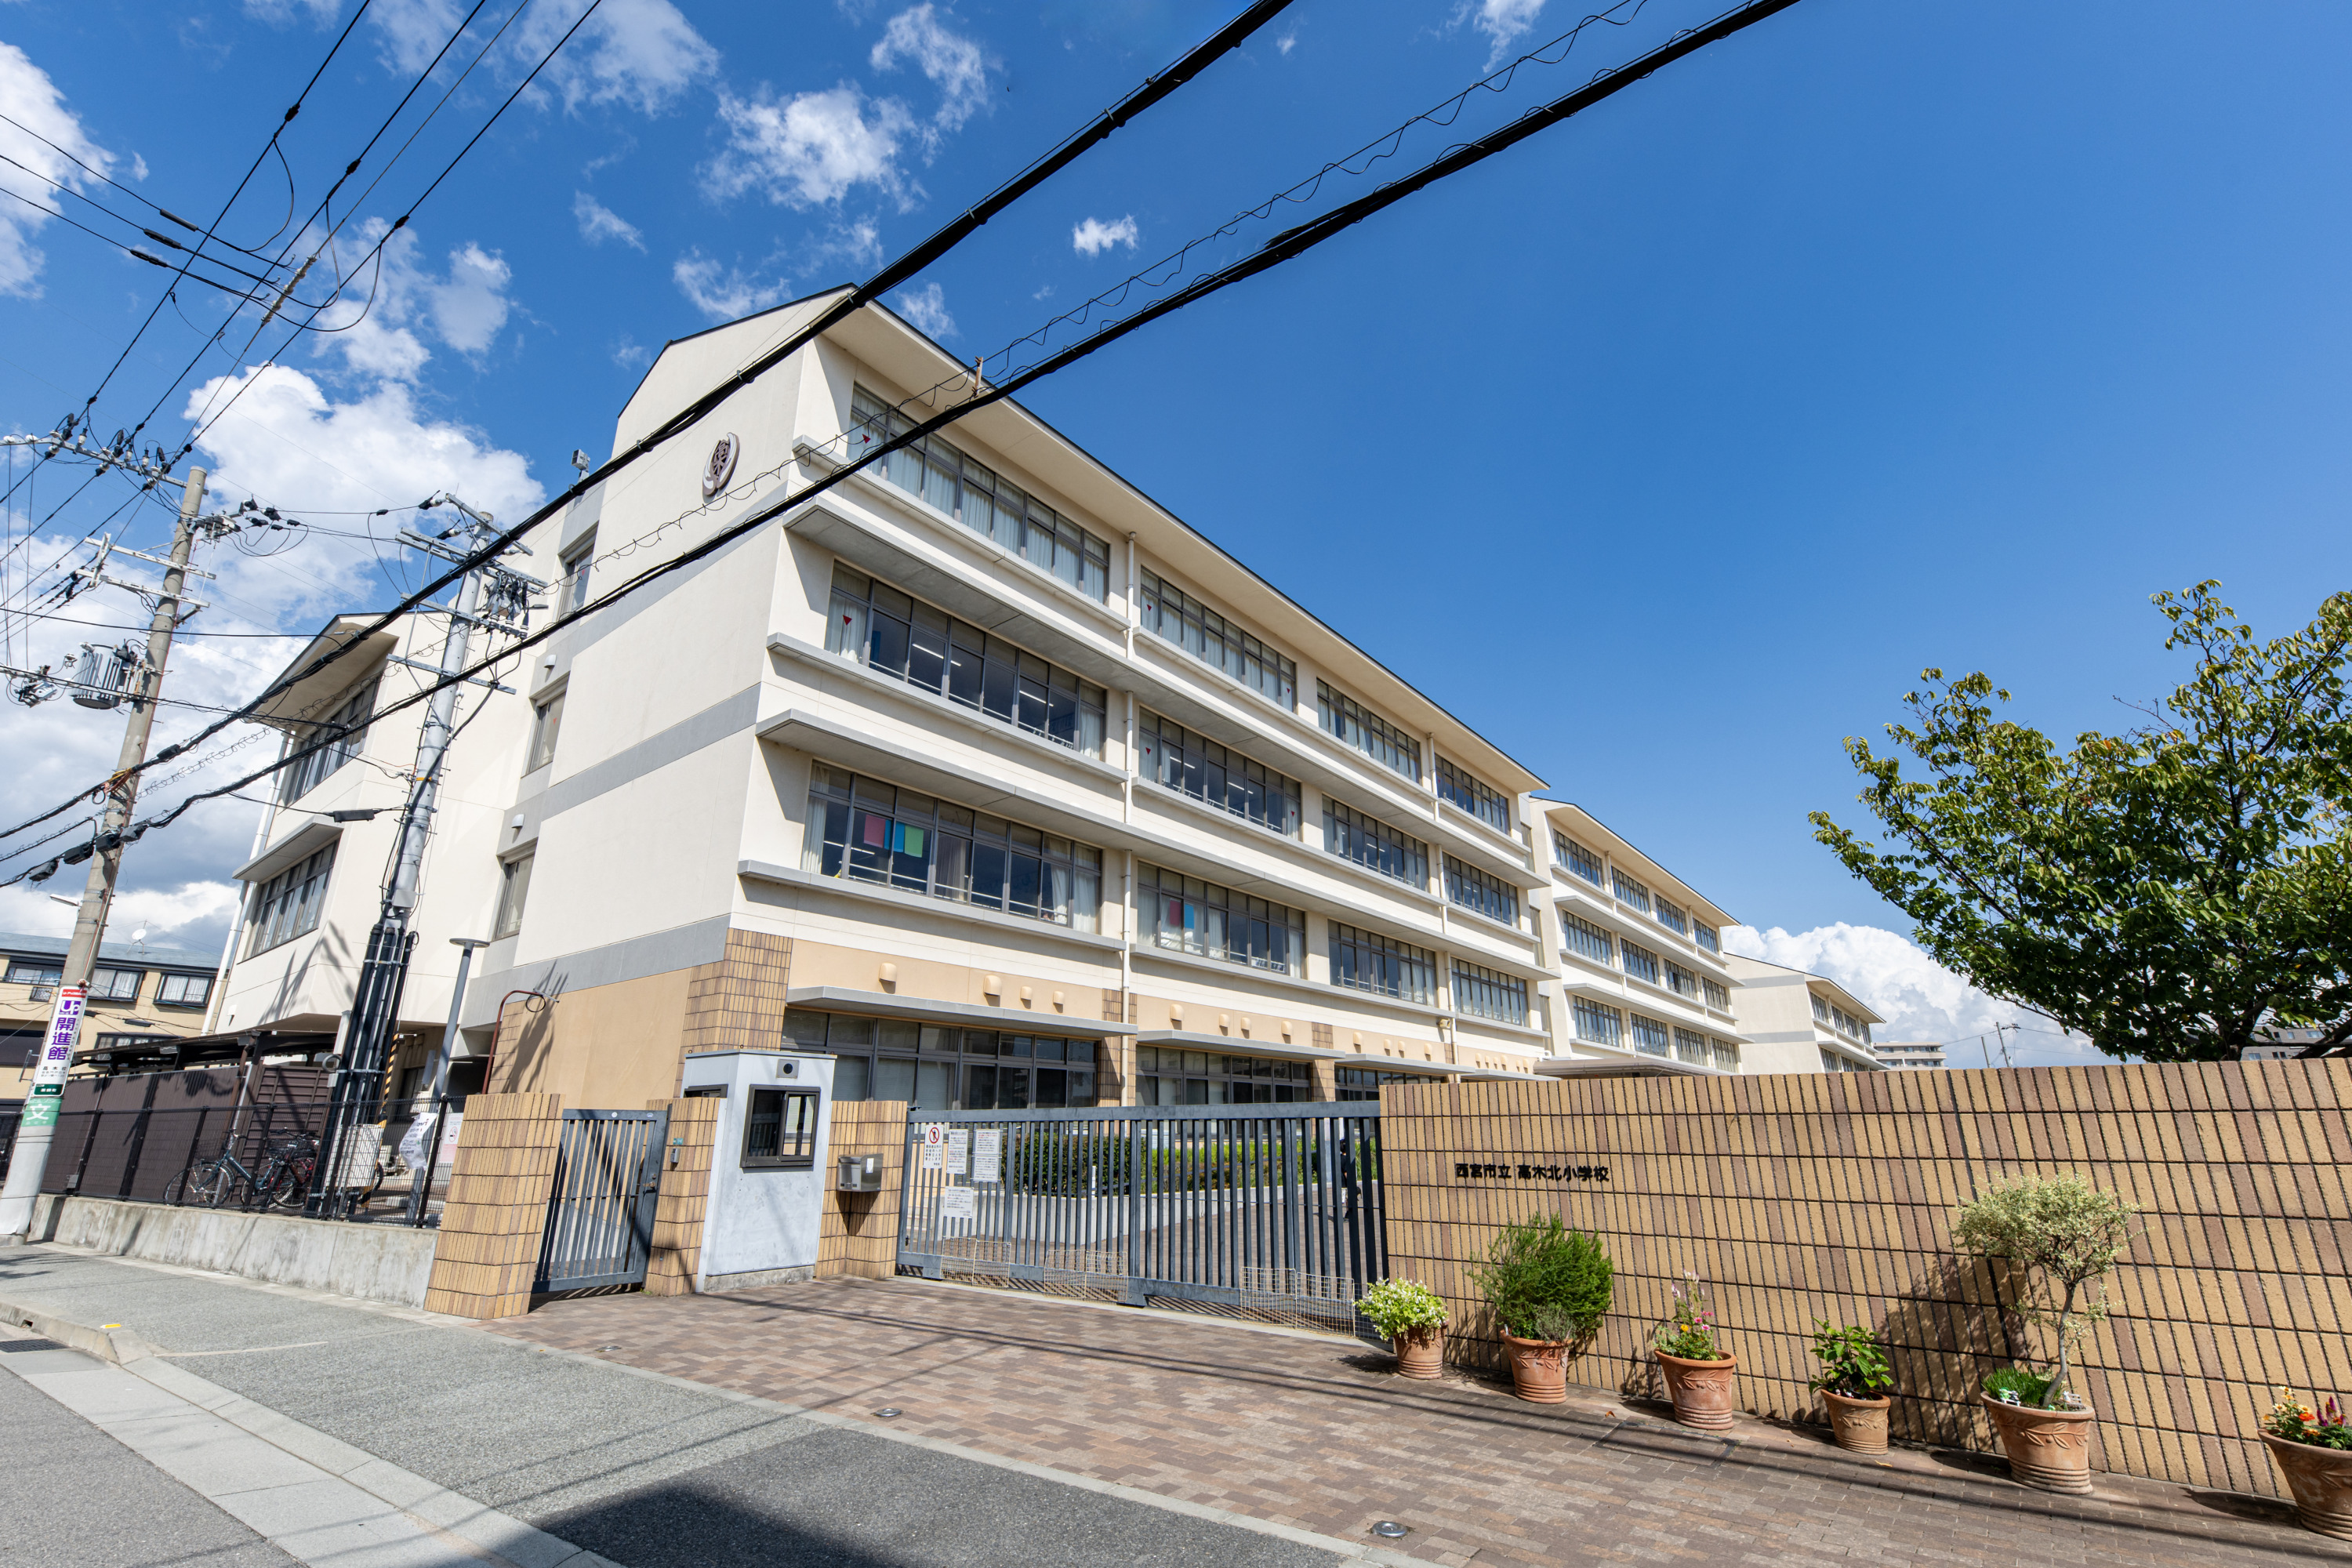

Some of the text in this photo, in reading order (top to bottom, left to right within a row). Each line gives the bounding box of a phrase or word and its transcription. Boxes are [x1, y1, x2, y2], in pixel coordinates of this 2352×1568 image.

[48, 1017, 76, 1060] 開進館
[26, 1103, 51, 1120] 文
[1455, 1163, 1610, 1182] 西宮市立 高木北小学校
